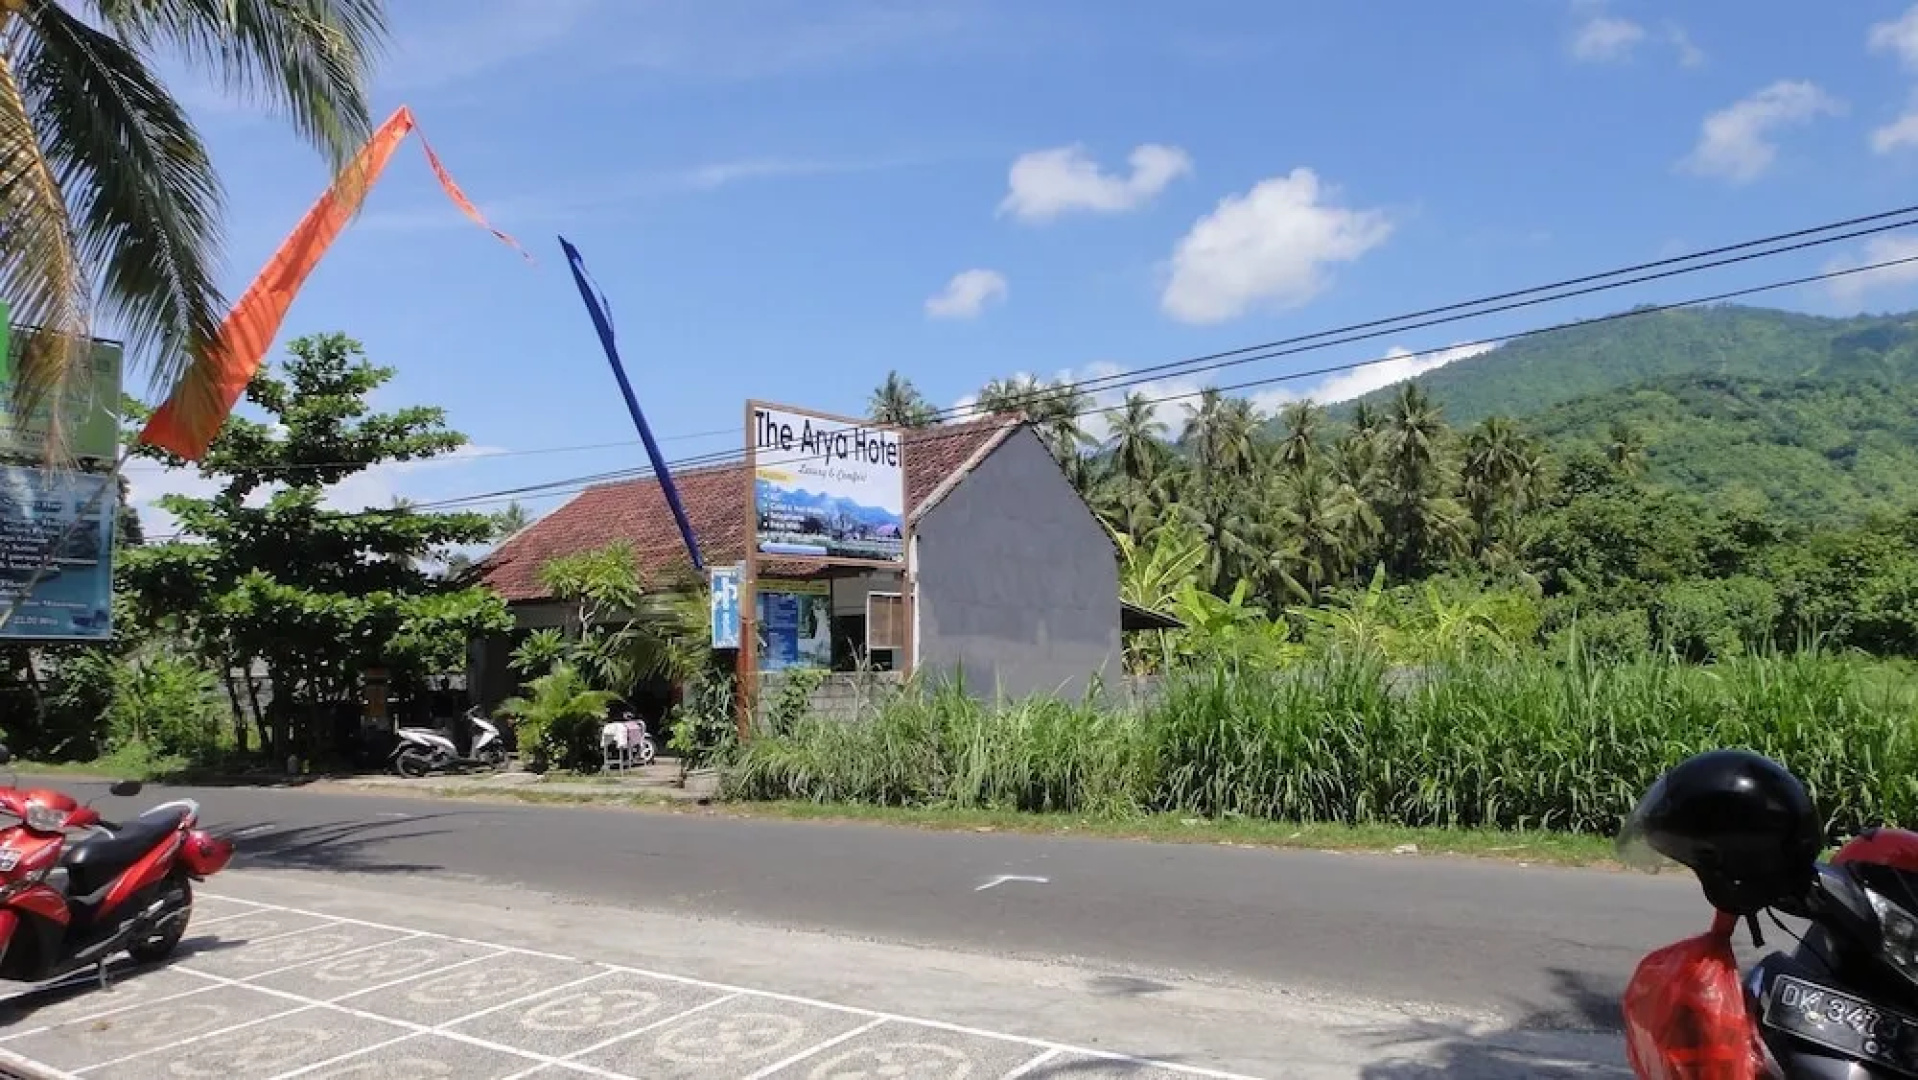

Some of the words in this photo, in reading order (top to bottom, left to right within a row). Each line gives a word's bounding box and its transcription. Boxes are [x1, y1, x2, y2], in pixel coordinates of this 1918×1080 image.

[755, 411, 793, 450] The
[802, 420, 847, 465] Arya
[855, 428, 902, 468] Hotel
[836, 469, 868, 483] Comfort
[1782, 984, 1824, 1013] DK
